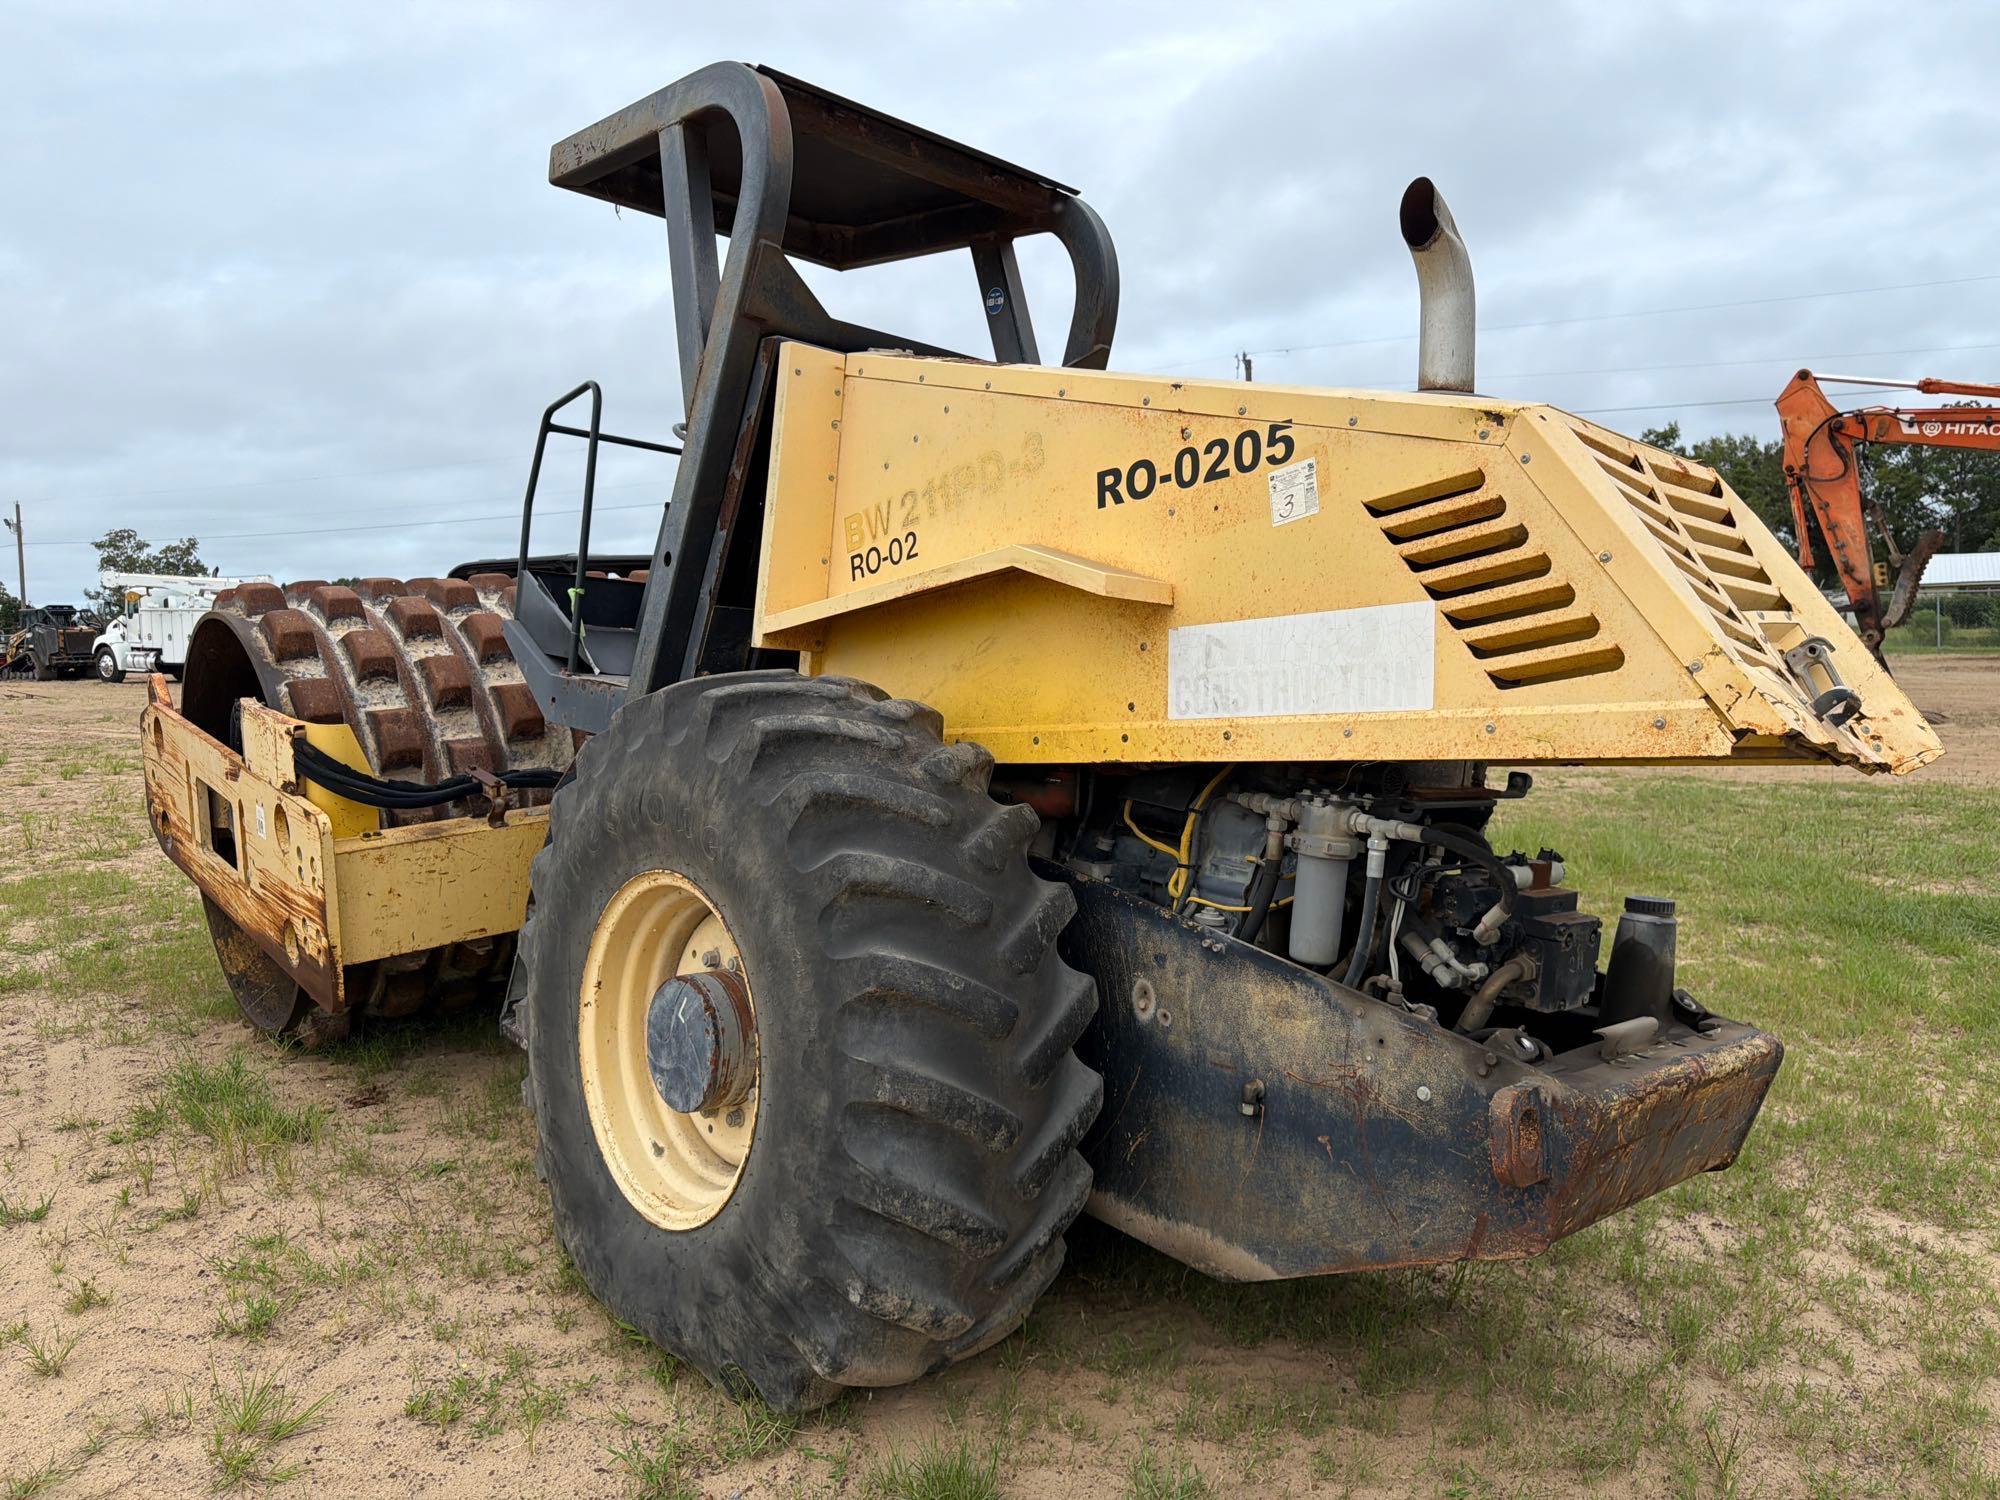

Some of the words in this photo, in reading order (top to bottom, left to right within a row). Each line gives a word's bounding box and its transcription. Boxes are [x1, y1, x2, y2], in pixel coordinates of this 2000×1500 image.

[1096, 419, 1296, 509] RO-0205
[843, 496, 892, 553] BW
[1279, 494, 1295, 518] 3
[849, 530, 919, 582] RO-02
